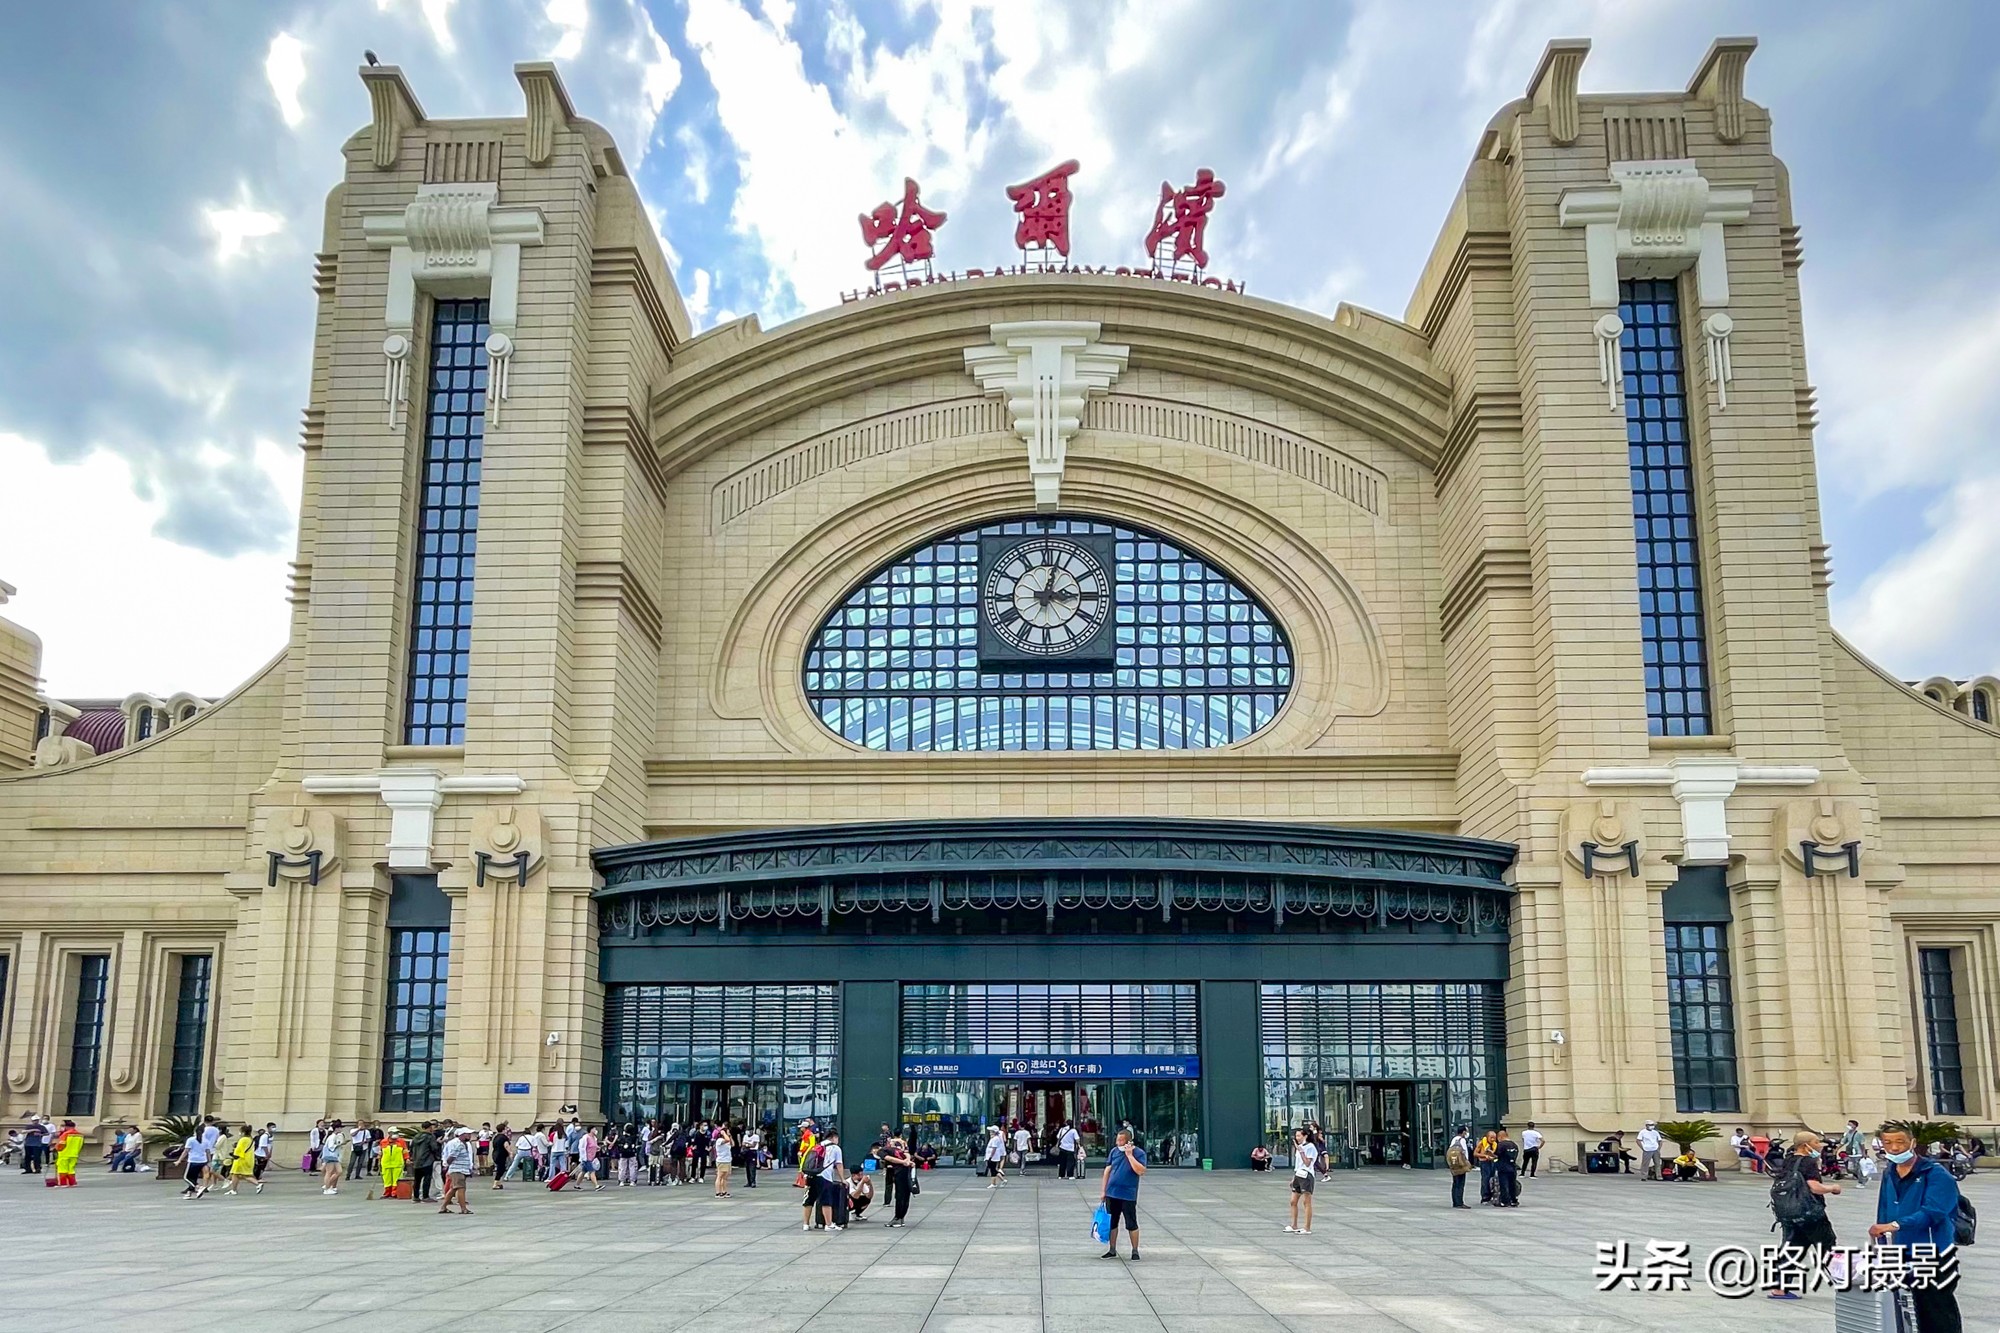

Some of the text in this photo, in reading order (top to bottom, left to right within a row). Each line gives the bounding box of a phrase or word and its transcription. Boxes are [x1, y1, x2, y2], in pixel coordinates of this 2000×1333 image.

[1030, 1059, 1057, 1069] 进站口
[1057, 1060, 1068, 1074] 3
